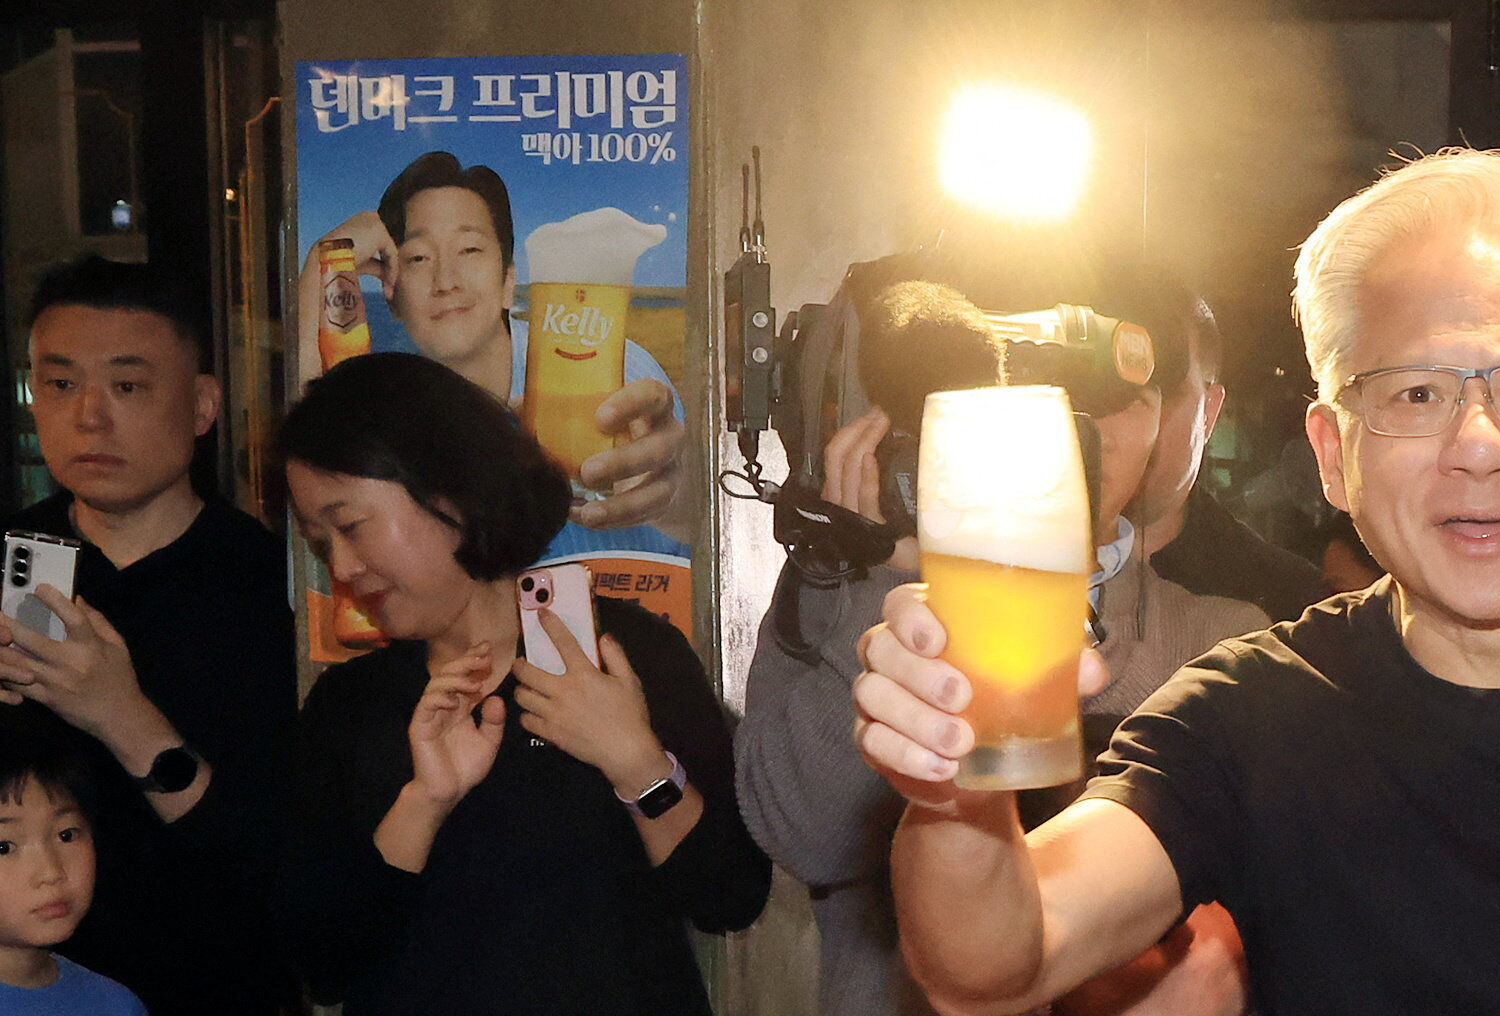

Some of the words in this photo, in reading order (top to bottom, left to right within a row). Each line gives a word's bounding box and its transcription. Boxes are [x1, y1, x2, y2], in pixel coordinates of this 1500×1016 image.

[308, 74, 458, 133] 덴마크
[468, 70, 676, 130] 프리미엄
[521, 132, 582, 166] 맥아
[586, 131, 676, 166] 100%
[542, 303, 616, 346] Kelly
[634, 574, 671, 592] 라거
